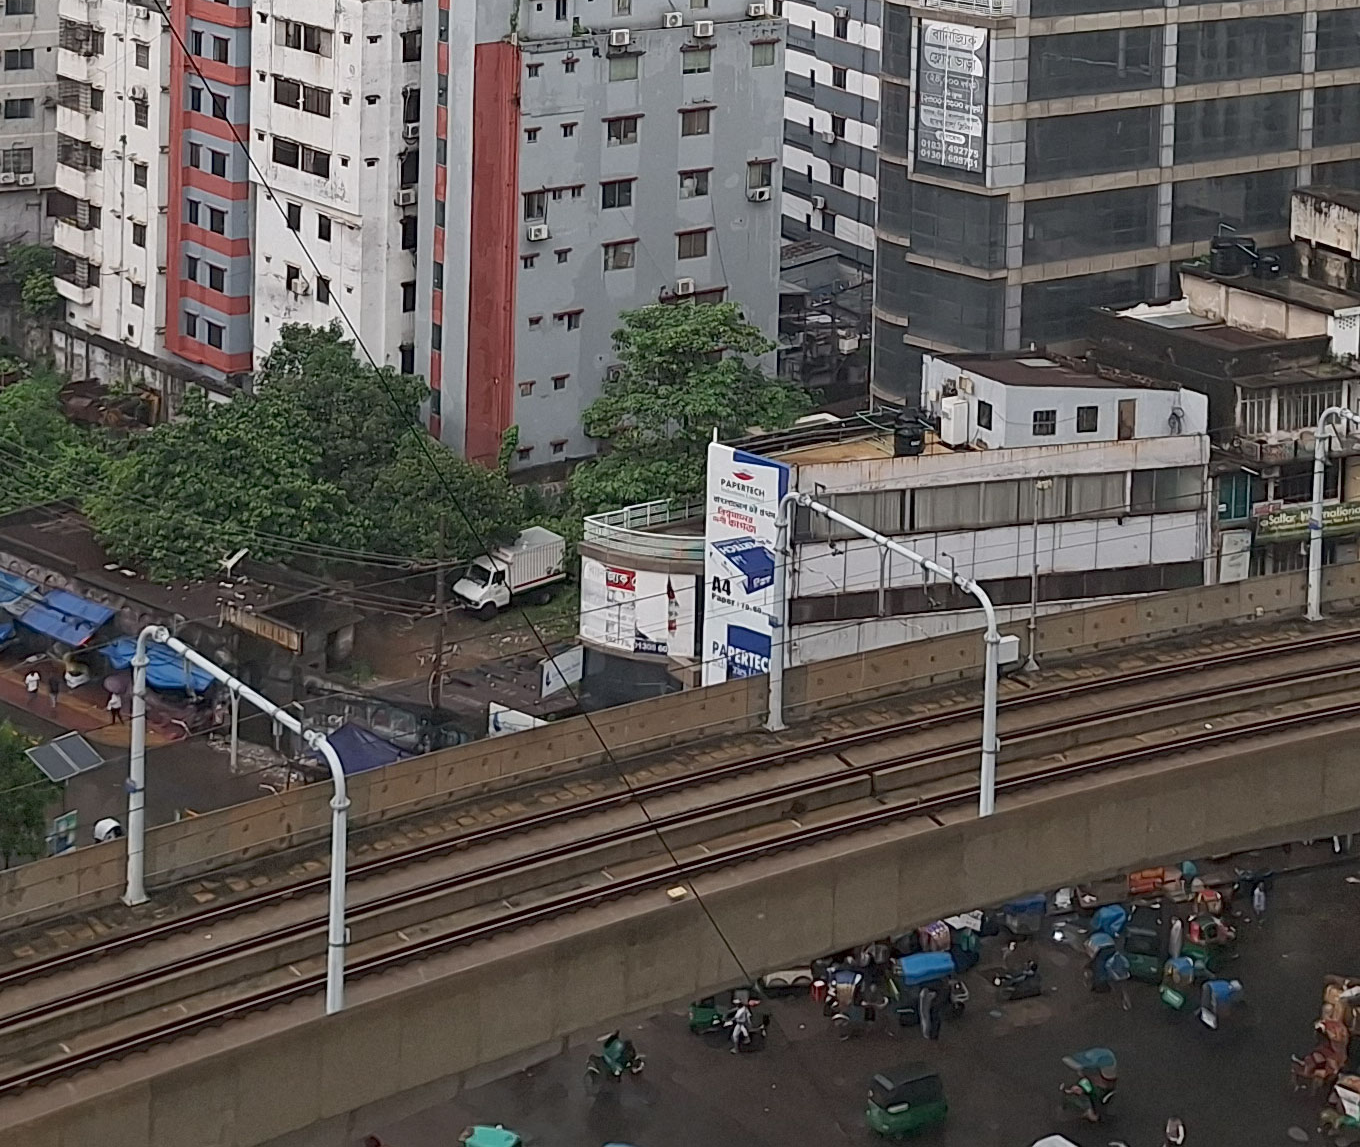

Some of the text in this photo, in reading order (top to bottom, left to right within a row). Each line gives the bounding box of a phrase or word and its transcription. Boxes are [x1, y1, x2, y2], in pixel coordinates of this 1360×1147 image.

[720, 478, 765, 498] PAPERTECH
[711, 575, 732, 597] A4
[711, 592, 735, 607] Paper
